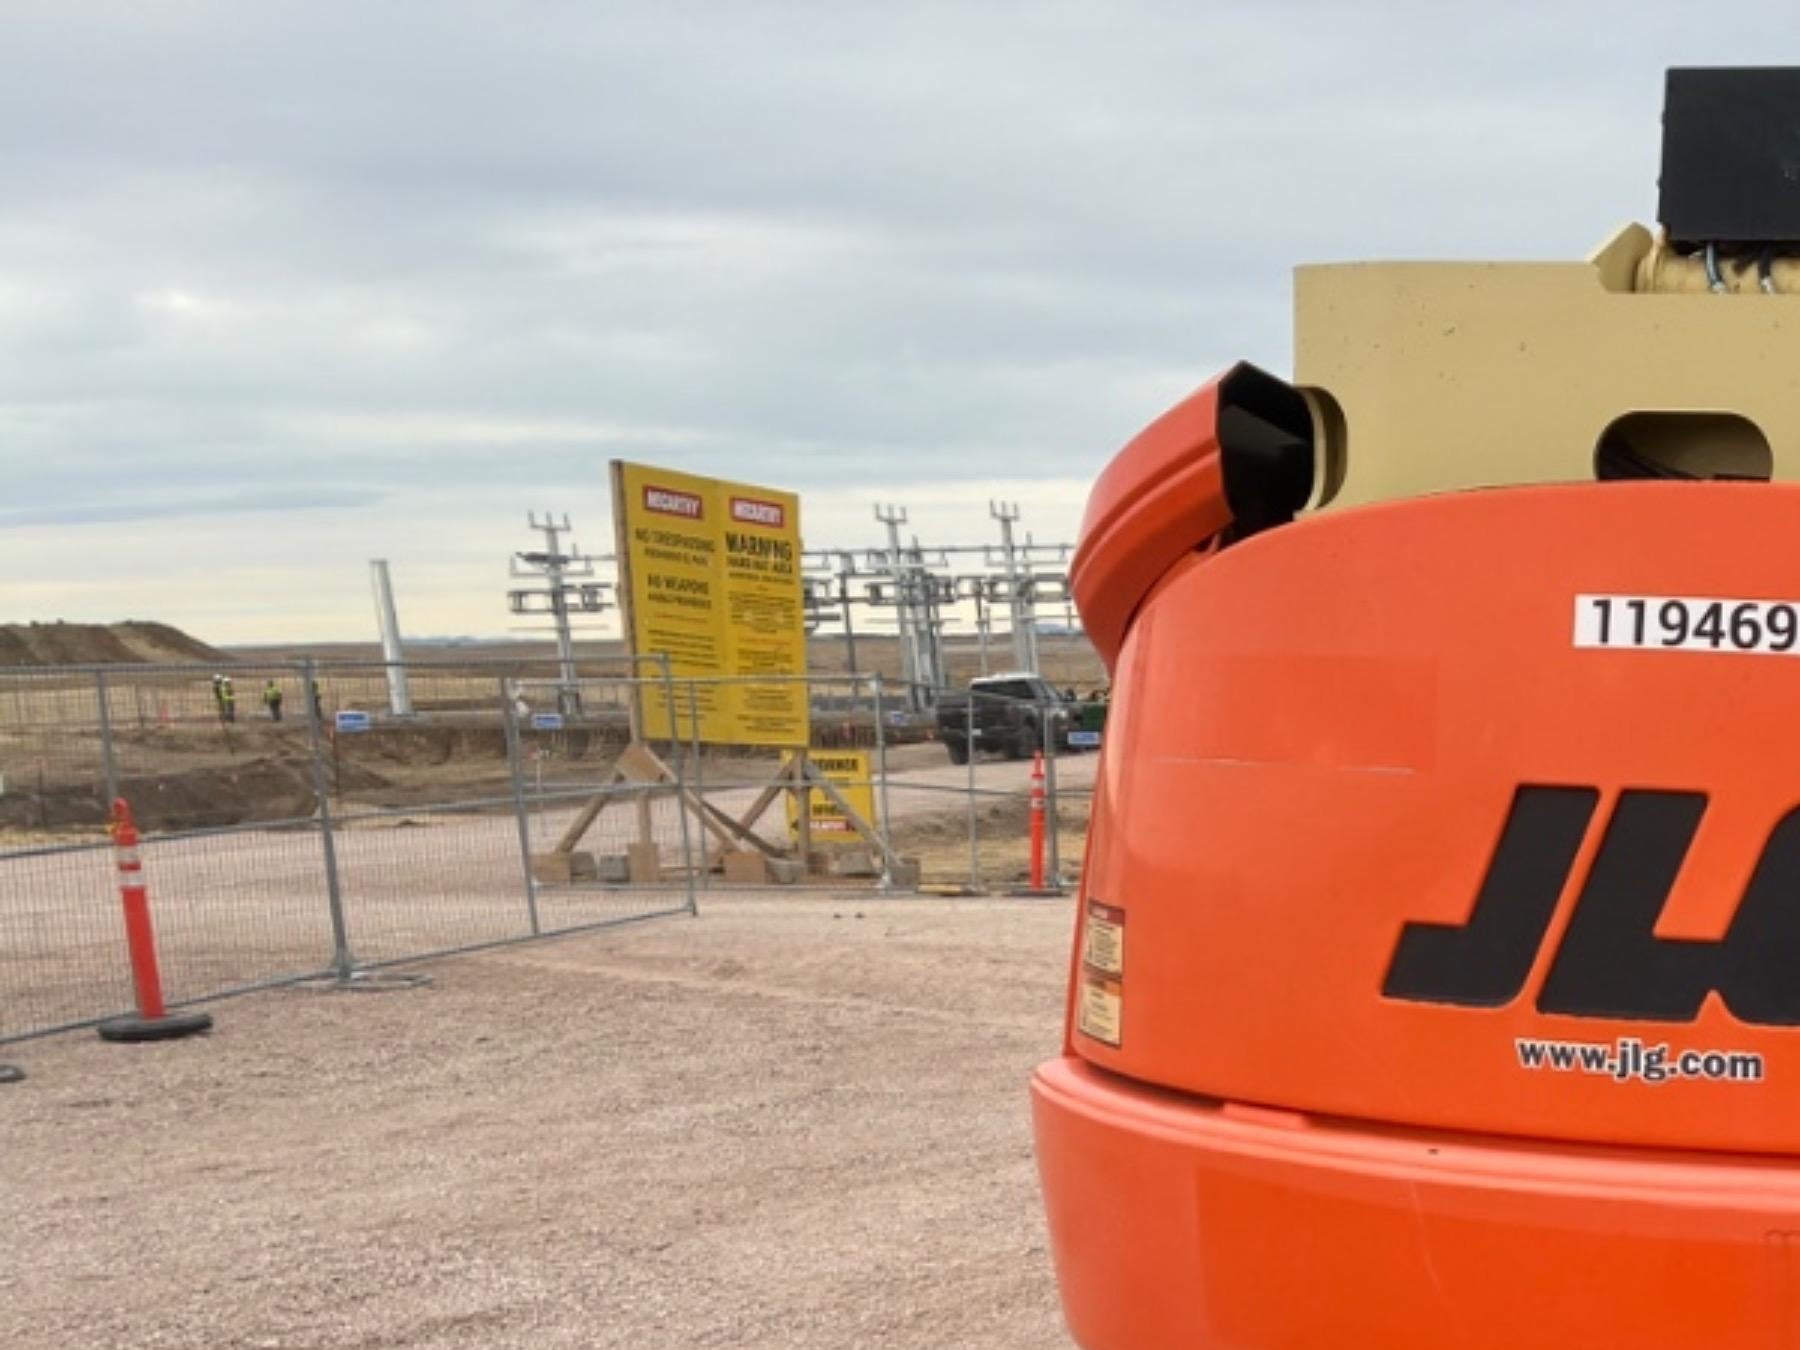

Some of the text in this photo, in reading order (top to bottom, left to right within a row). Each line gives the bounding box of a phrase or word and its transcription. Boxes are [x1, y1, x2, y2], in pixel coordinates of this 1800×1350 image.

[725, 531, 793, 561] WARNING
[1593, 599, 1798, 651] 119469
[1516, 1037, 1764, 1081] www.jlg.com
